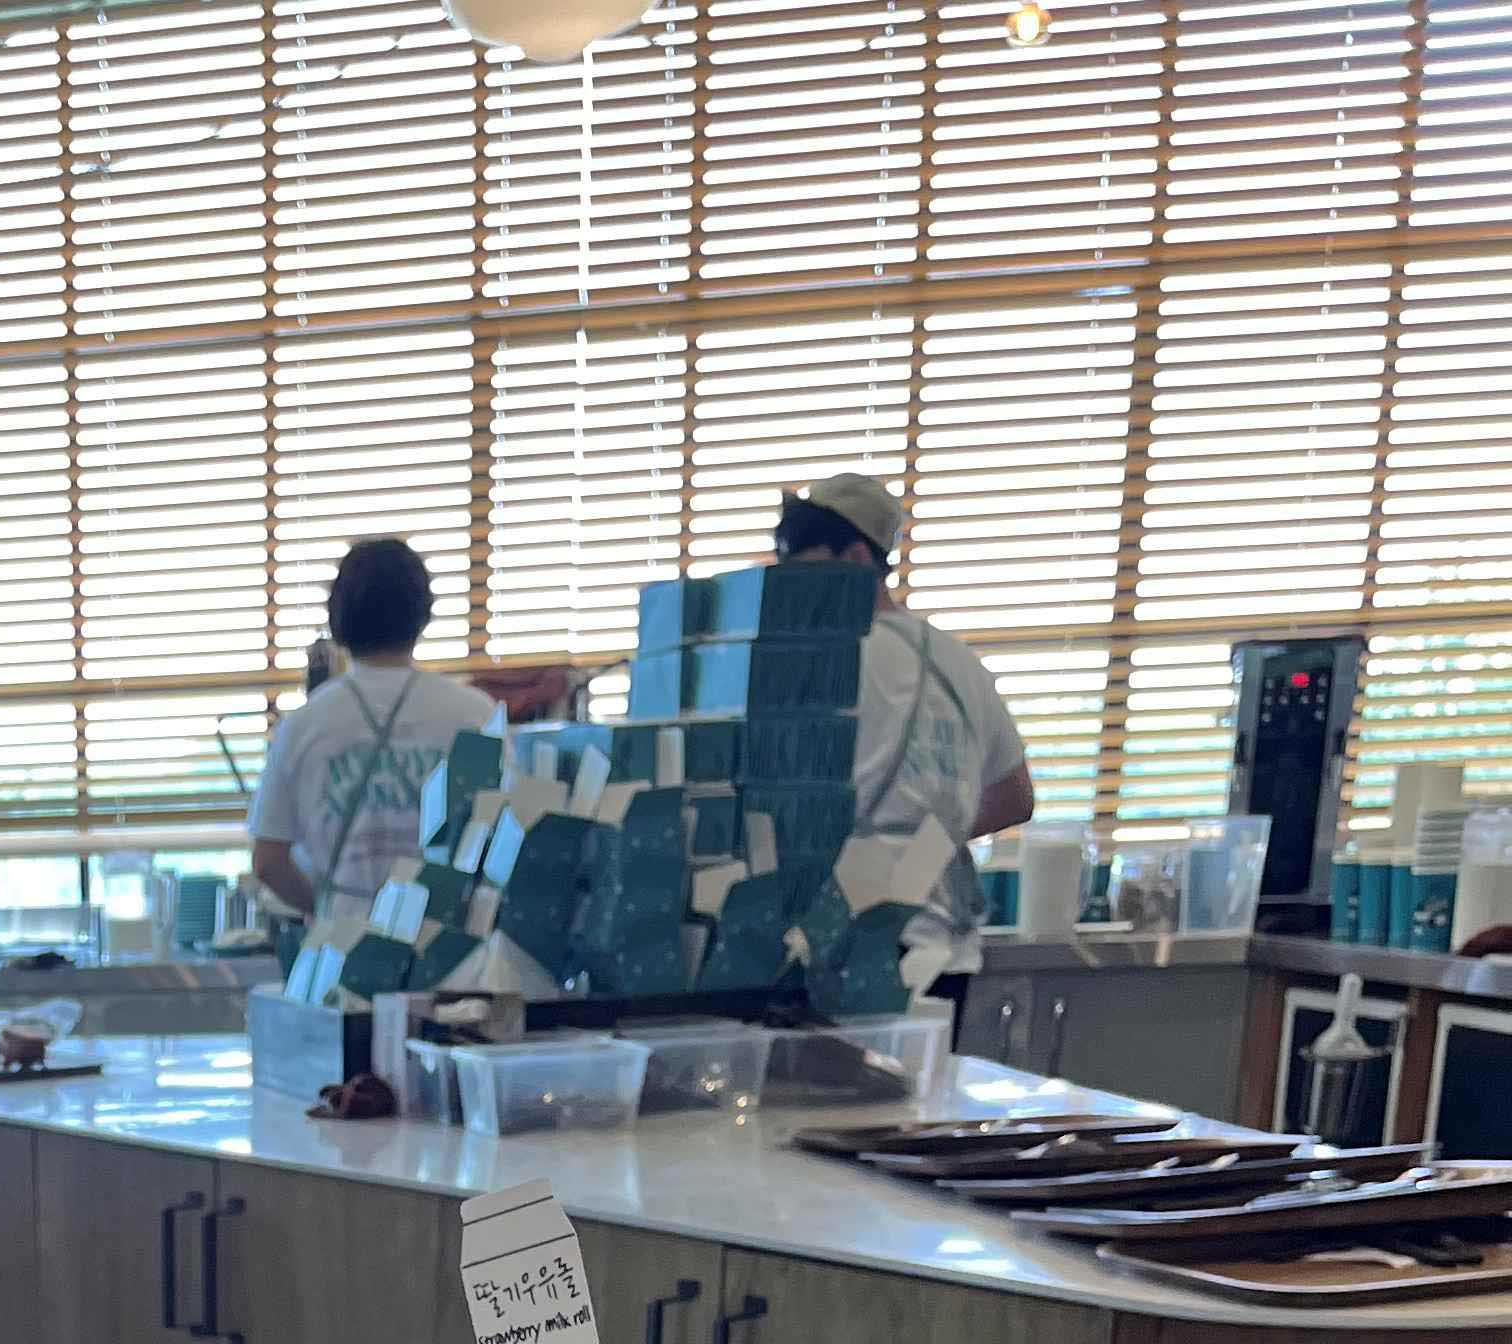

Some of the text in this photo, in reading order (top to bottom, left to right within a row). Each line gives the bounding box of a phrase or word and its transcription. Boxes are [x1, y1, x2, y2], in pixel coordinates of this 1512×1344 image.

[472, 1256, 581, 1319] 딸기우유롤
[544, 1312, 572, 1333] milk
[573, 1305, 592, 1327] roll
